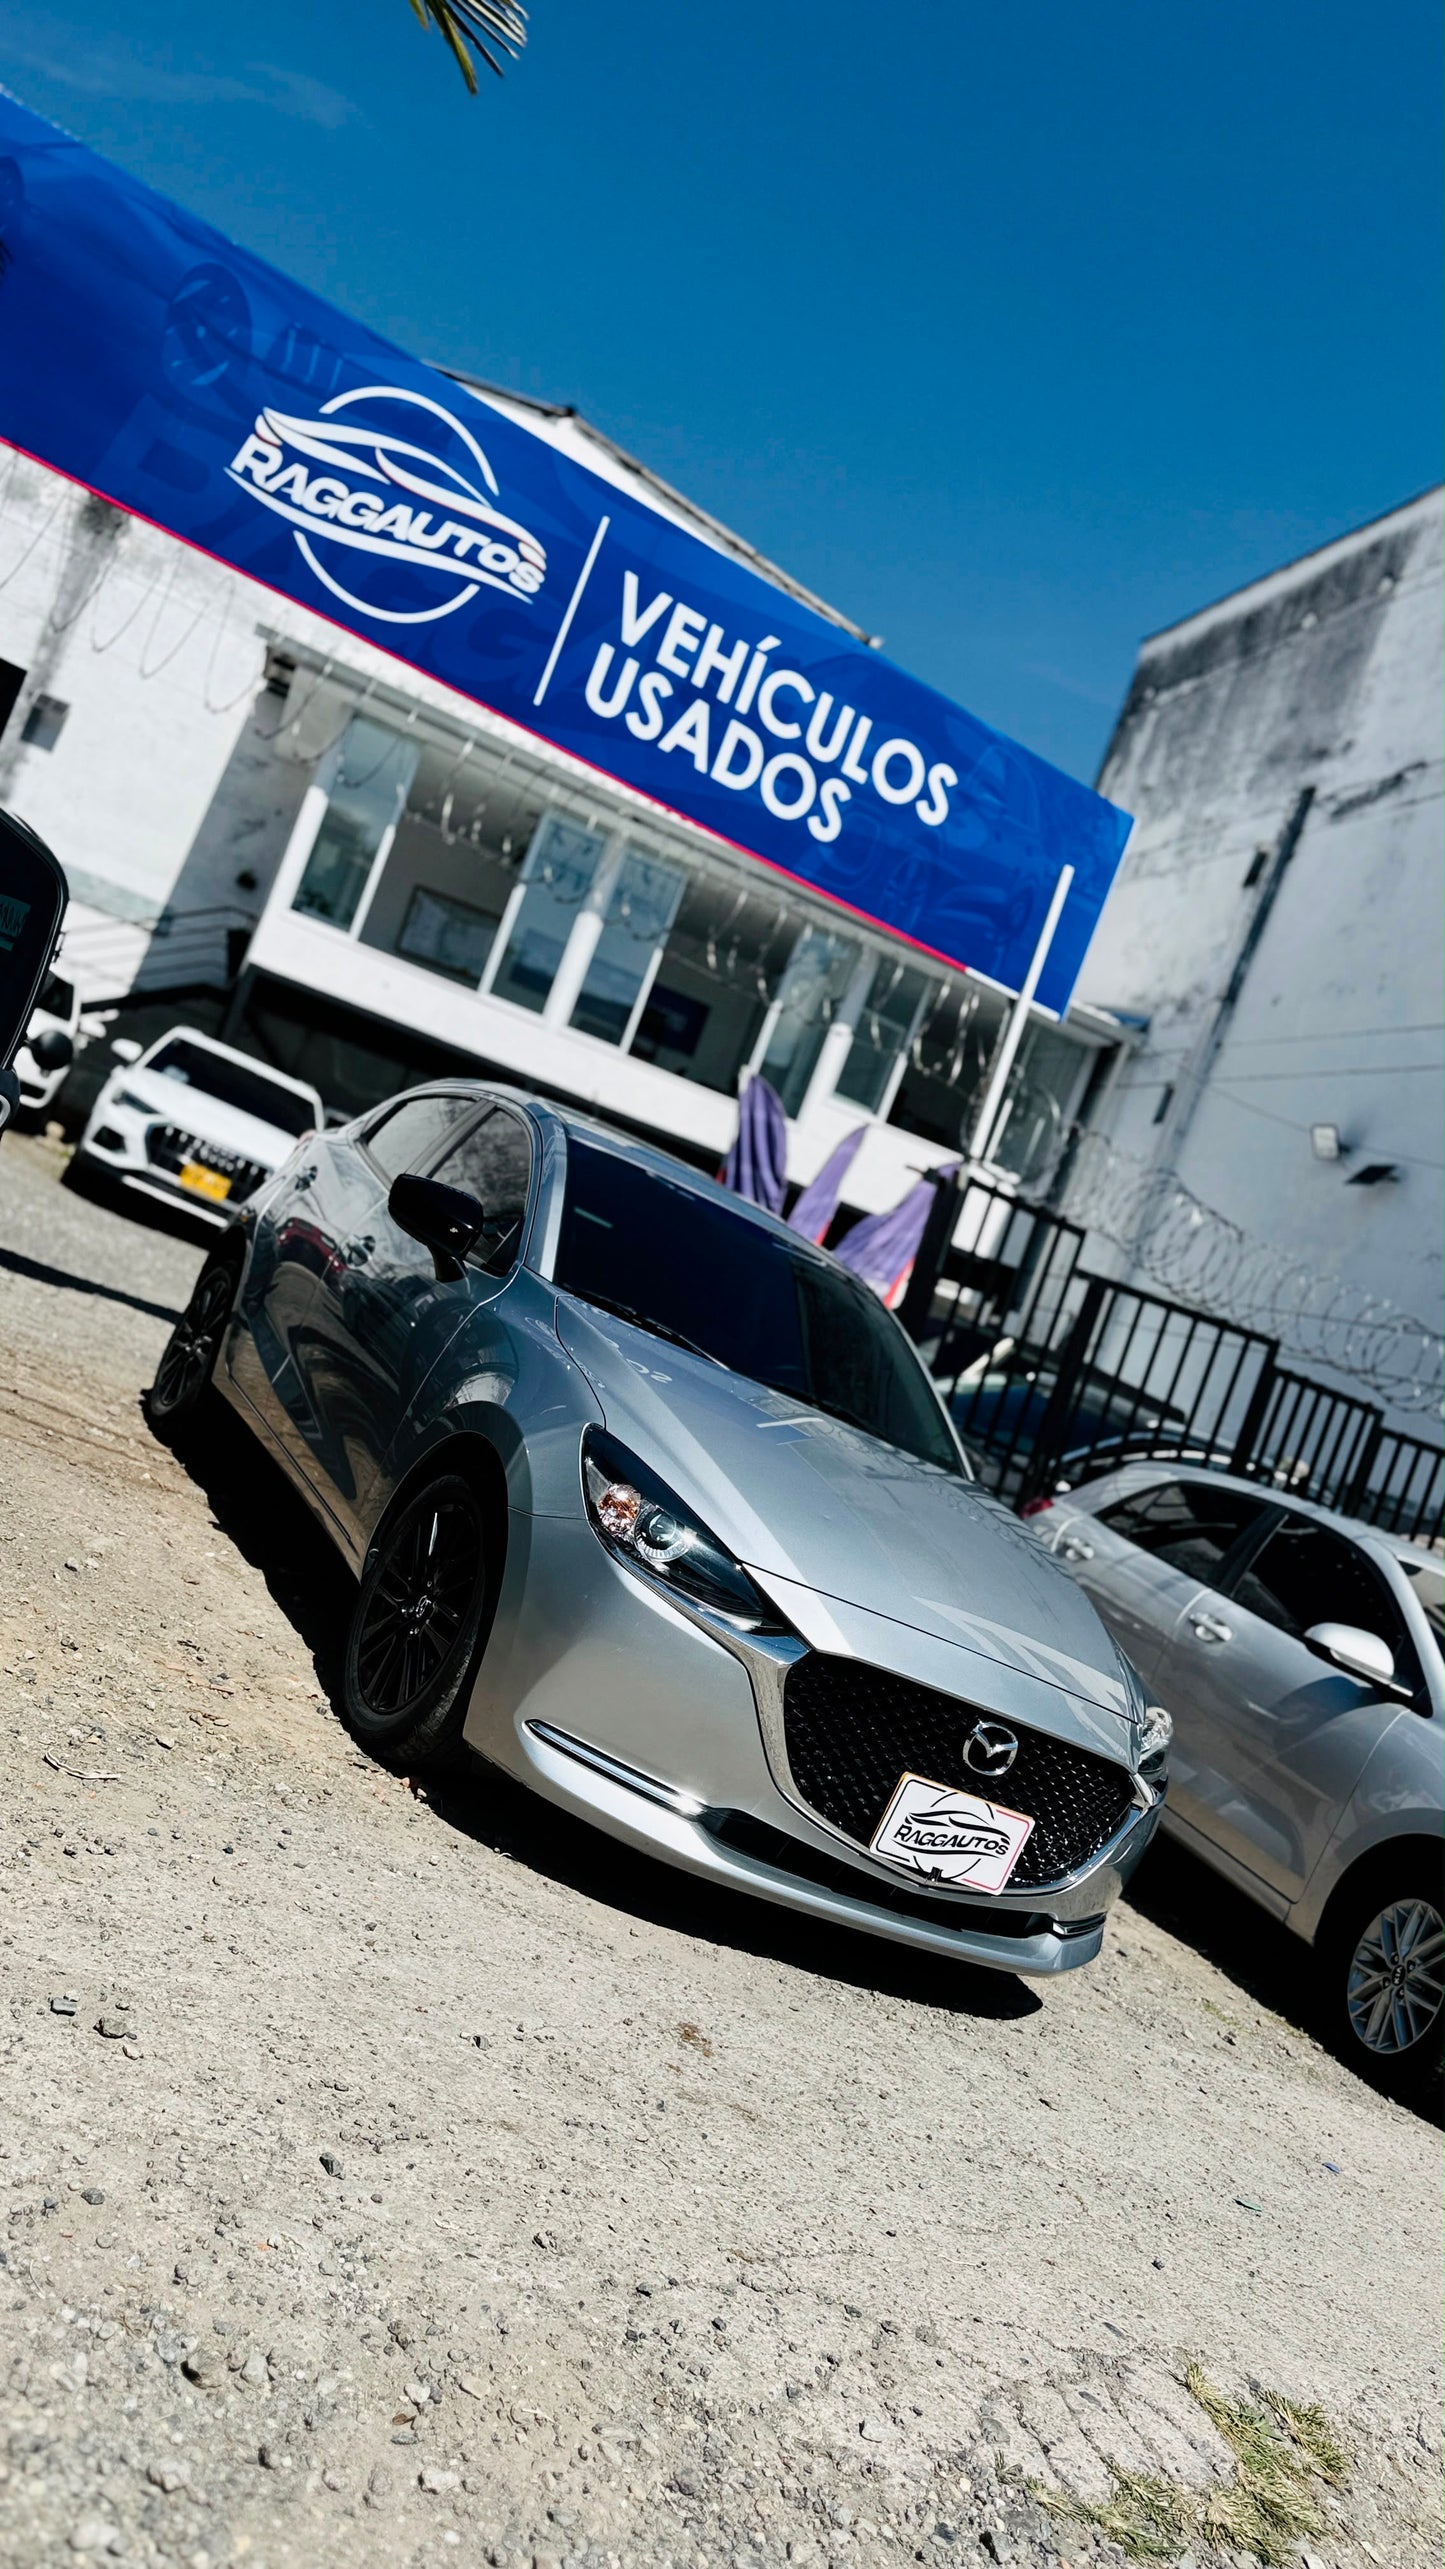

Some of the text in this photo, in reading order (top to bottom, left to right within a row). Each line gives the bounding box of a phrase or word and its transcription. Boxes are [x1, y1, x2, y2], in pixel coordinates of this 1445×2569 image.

[230, 433, 545, 594] RAGGAUTOS
[585, 642, 852, 843] USADOS
[621, 570, 958, 826] VEHÍCULOS
[893, 1824, 1009, 1855] RAGGAUTOS
